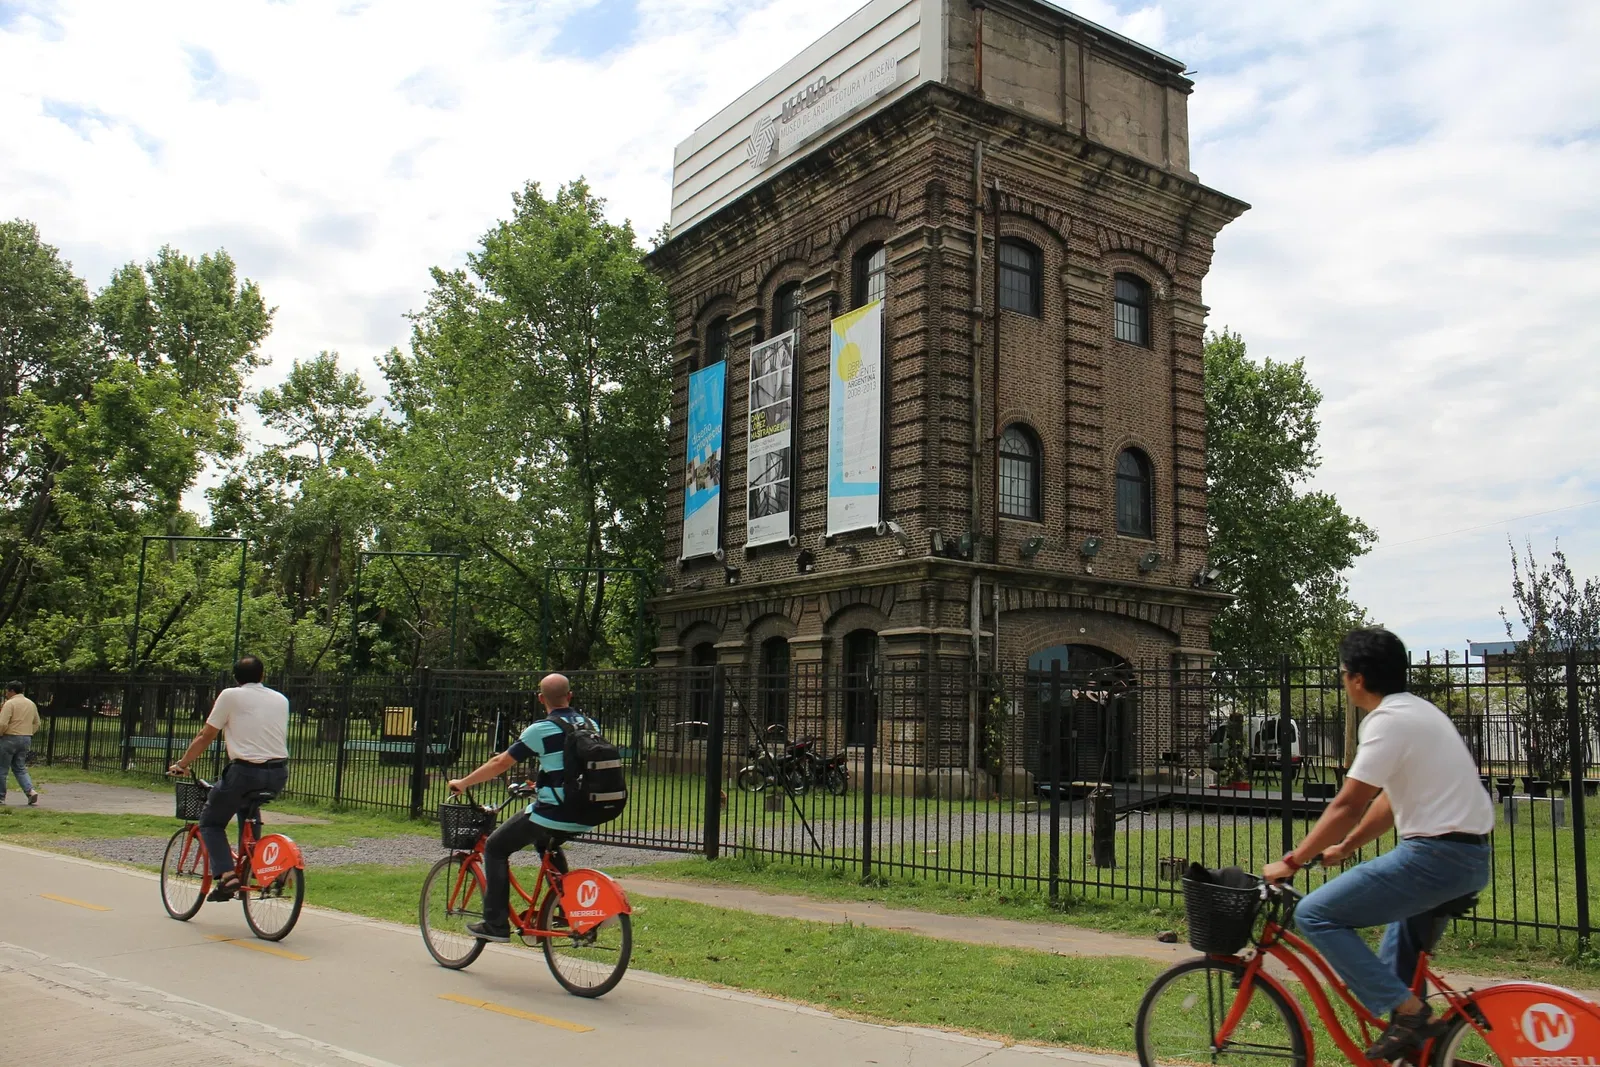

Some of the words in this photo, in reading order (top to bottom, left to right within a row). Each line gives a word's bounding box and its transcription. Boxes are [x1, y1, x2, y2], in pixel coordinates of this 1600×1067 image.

[780, 119, 800, 137] MUSEO
[802, 112, 812, 126] DE
[812, 81, 861, 119] ARQUITECTURA
[861, 75, 868, 86] Y
[847, 359, 864, 372] OBRA
[847, 362, 876, 380] RECIENTE
[847, 373, 876, 389] ARGENTINA
[1511, 1056, 1600, 1067] MERRELL
